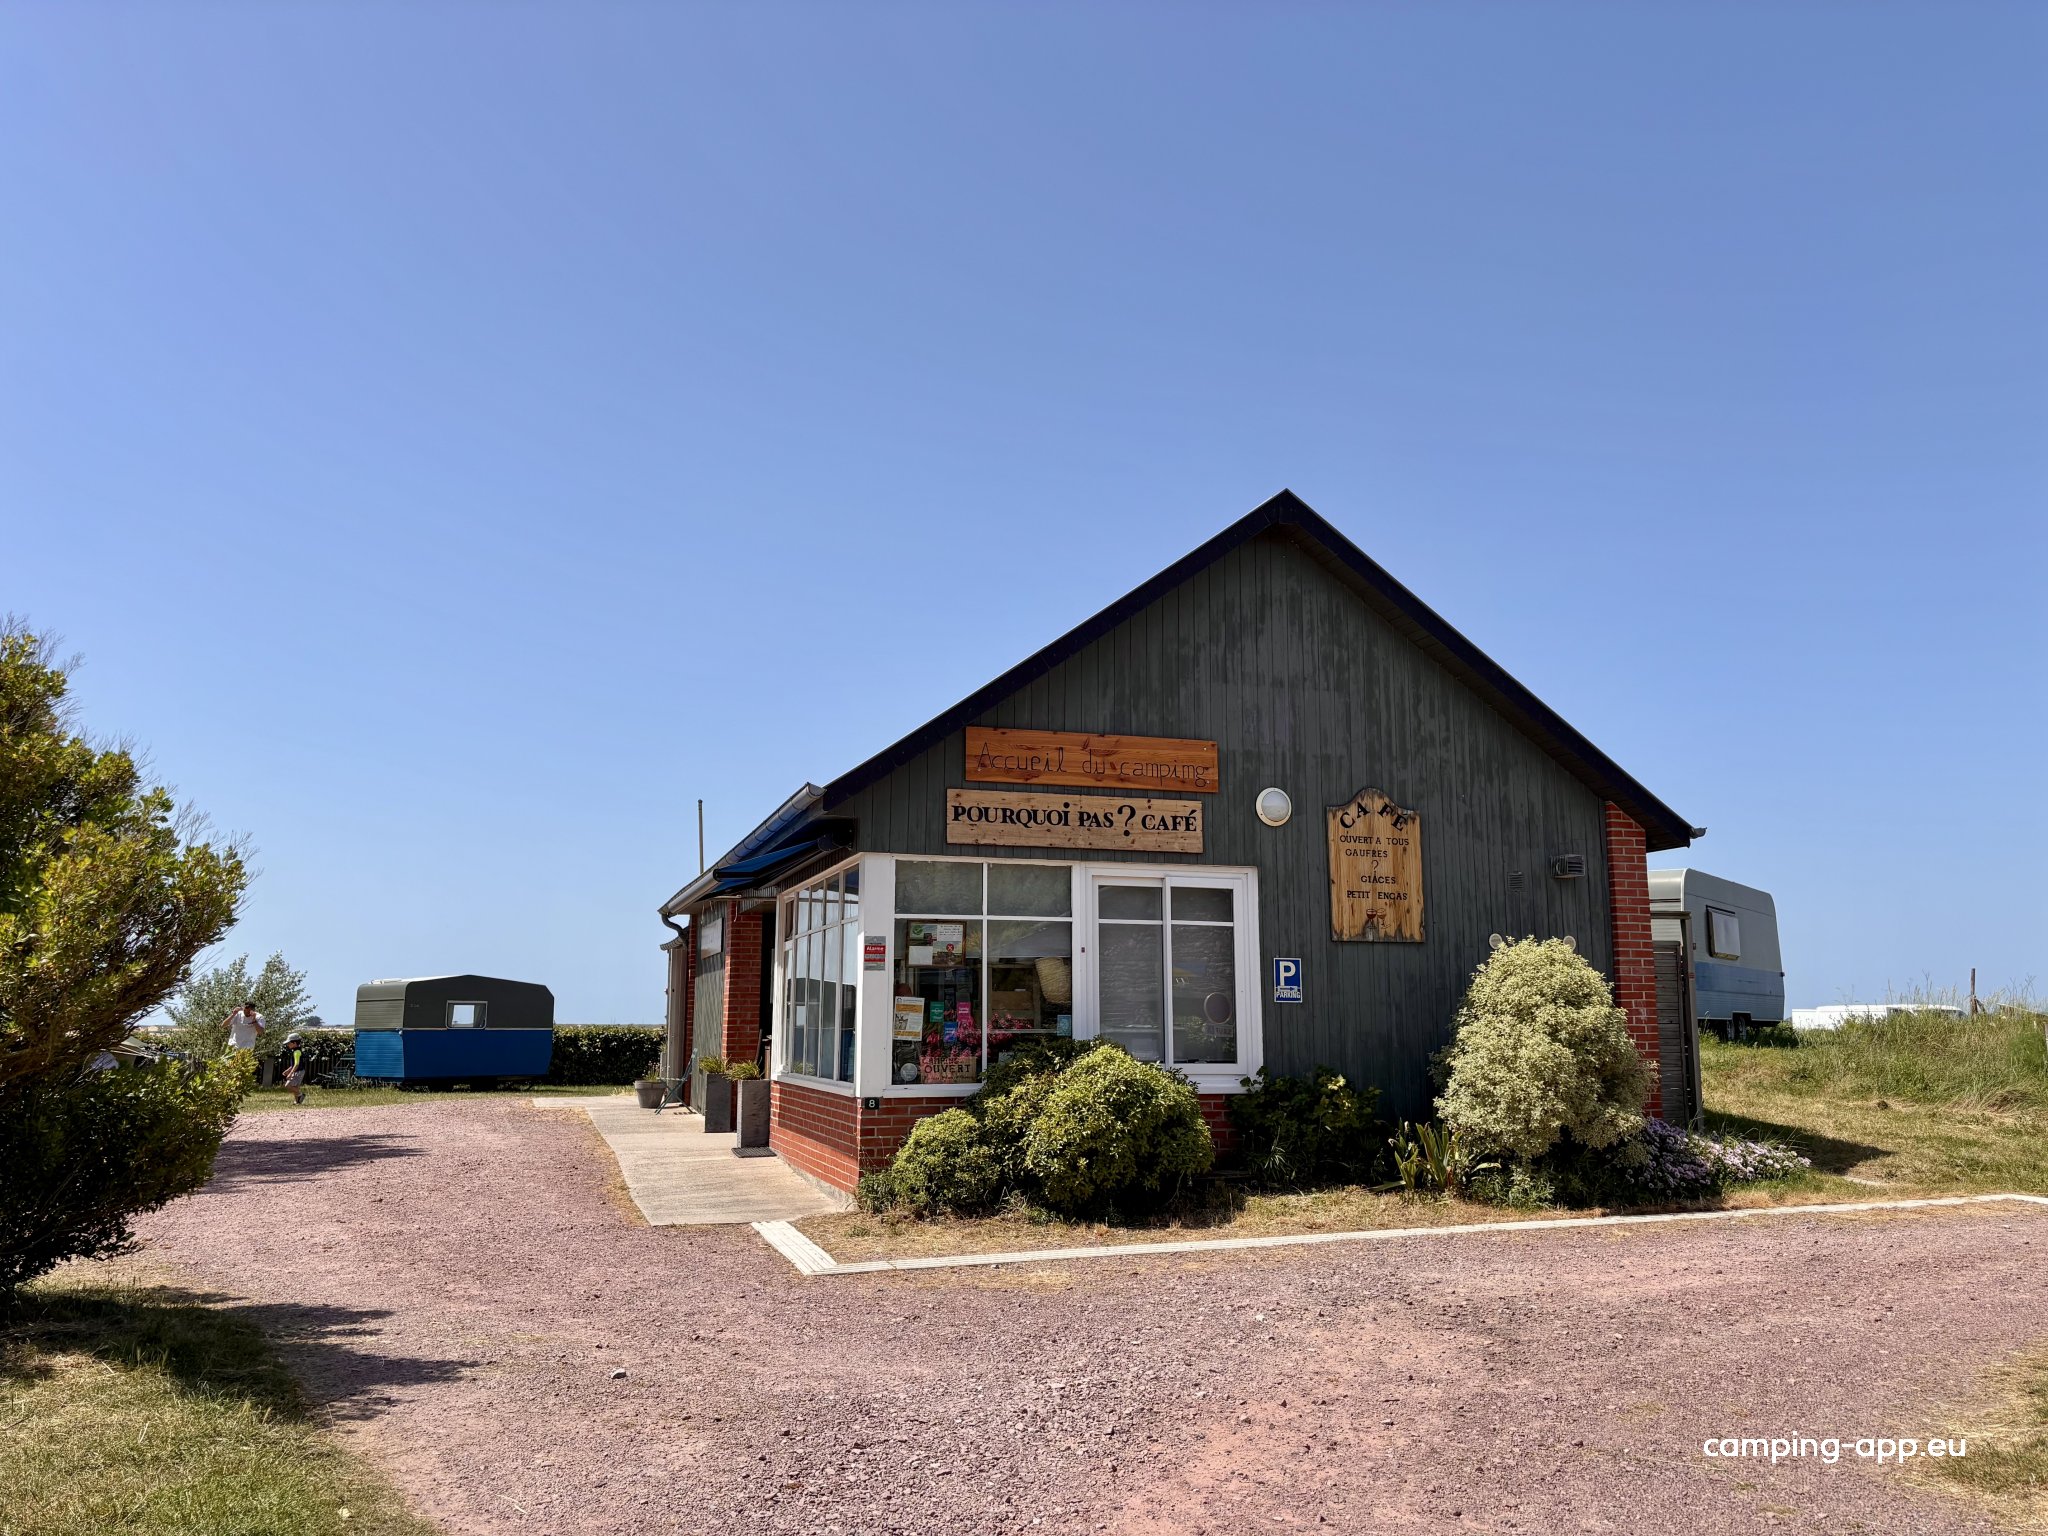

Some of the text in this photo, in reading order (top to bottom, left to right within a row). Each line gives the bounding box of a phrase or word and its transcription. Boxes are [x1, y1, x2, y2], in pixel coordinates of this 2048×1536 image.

[977, 741, 1067, 773] Accueil
[1081, 748, 1106, 775] du
[1077, 811, 1114, 828] PAS
[1141, 809, 1197, 832] CAFÉ
[1339, 834, 1374, 845] OUVERT
[1386, 837, 1410, 846] TOUS
[1345, 848, 1388, 858] GAUFRES
[1346, 890, 1371, 899] PETIT
[1279, 960, 1296, 987] P
[1276, 991, 1301, 999] PARKING
[925, 1064, 971, 1073] OUVERT
[868, 1099, 876, 1108] 8
